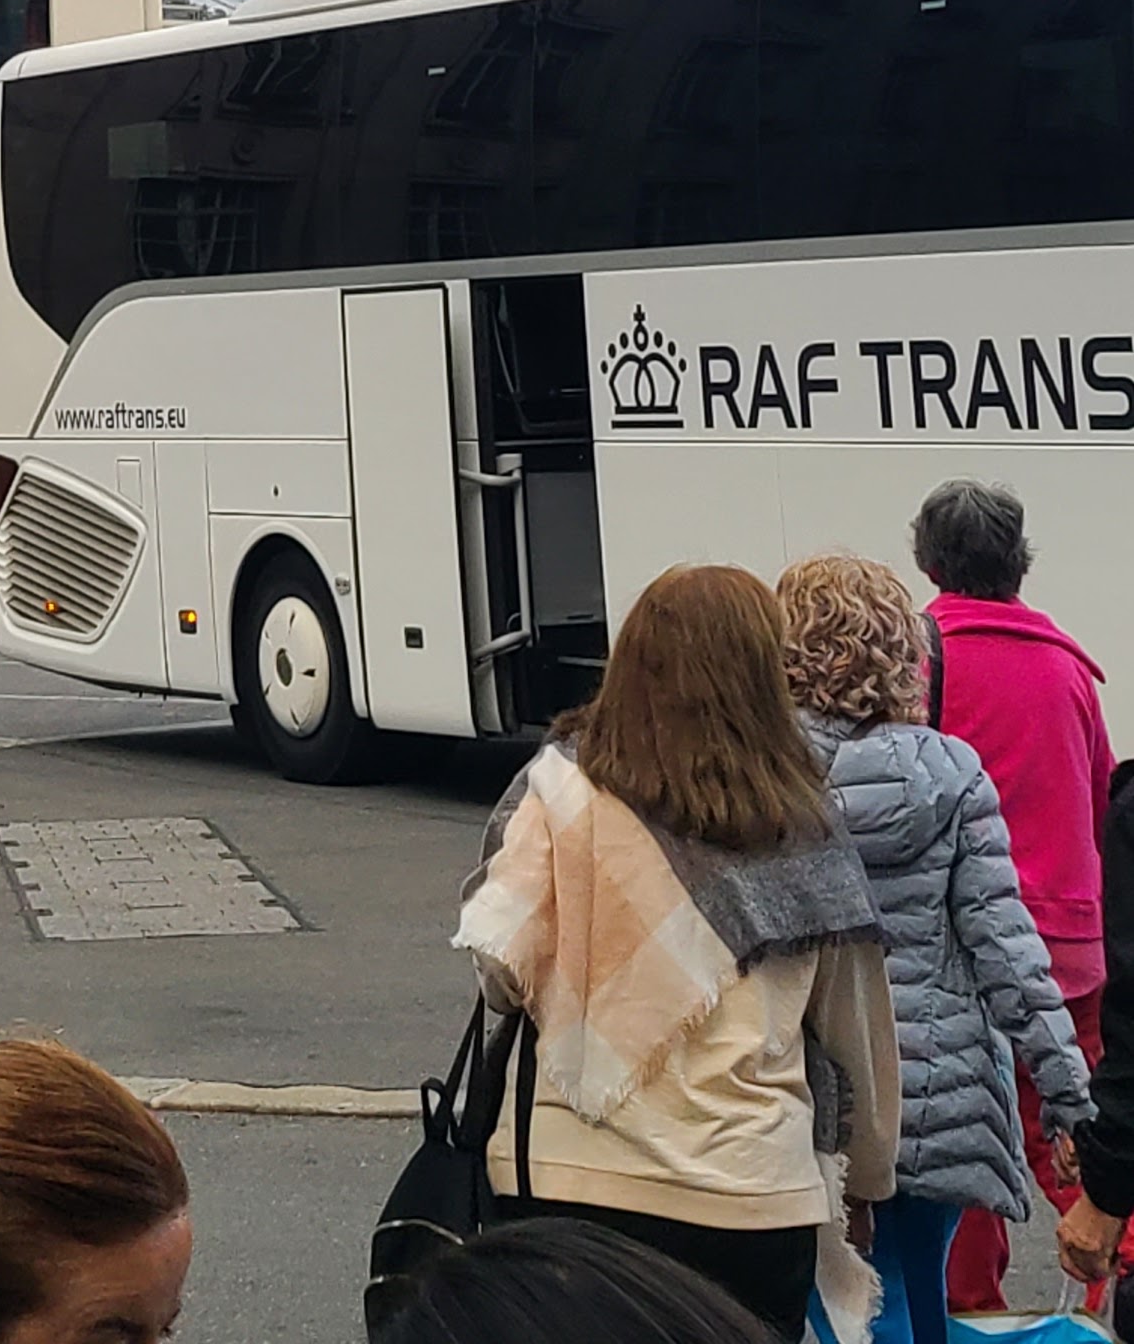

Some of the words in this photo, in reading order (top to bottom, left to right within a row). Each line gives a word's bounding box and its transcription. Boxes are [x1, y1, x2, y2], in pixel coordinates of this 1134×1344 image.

[698, 342, 839, 429] RAF
[859, 335, 1134, 431] TRANS
[55, 402, 186, 430] www.raftrans.eu
